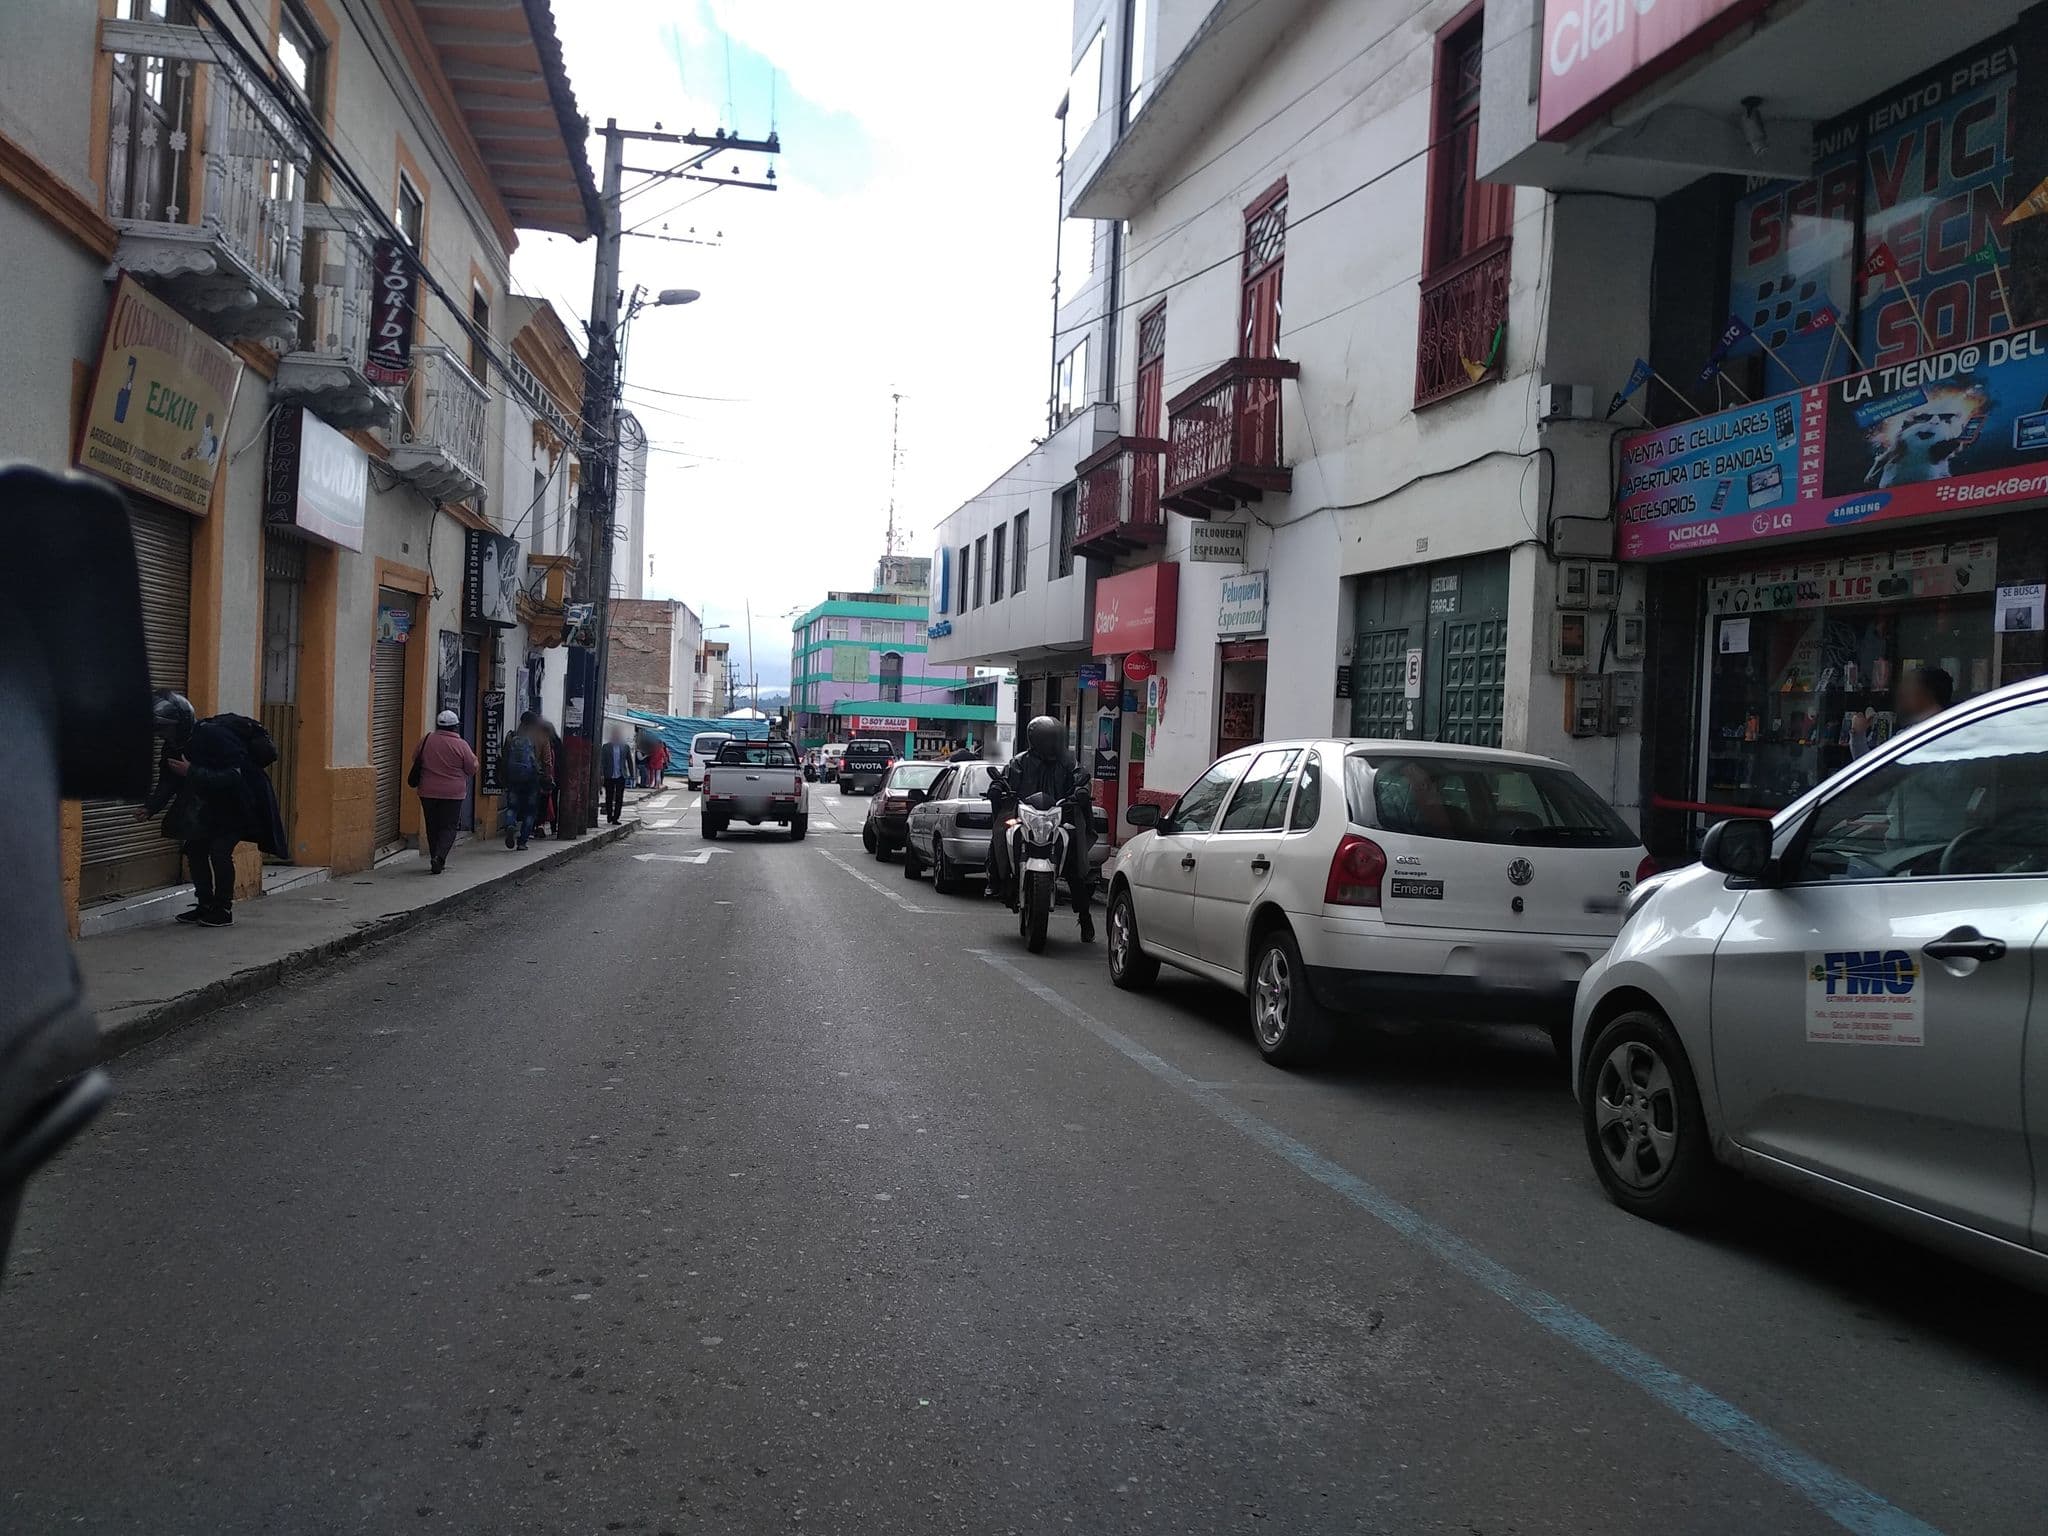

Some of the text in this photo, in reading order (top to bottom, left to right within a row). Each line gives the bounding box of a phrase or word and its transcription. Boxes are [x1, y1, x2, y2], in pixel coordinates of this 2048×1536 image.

[1867, 254, 1885, 273] LTC
[1975, 249, 1990, 262] LTC
[1812, 313, 1829, 329] LTC
[1722, 325, 1740, 347] LTC
[1700, 366, 1714, 381] LTC
[1842, 329, 2045, 403] LA TIEND@ DEL
[1627, 412, 1771, 465] VENTA DE CELULARES
[1801, 387, 1823, 499] INTERNET
[1625, 444, 1774, 497] APERTURA DE BANDAS
[1624, 494, 1697, 524] ACCESORIOS
[1834, 501, 1881, 518] SAMSUNG
[1773, 513, 1792, 529] LG
[1668, 522, 1719, 542] NOKIA
[1193, 544, 1241, 557] ESPERANZA
[1828, 576, 1873, 598] LTC
[2002, 585, 2040, 597] SE BUSCA
[1430, 597, 1456, 614] GARAJE
[1096, 610, 1115, 634] Claro
[1127, 662, 1147, 671] Claro
[884, 719, 907, 727] SALUD
[850, 762, 882, 770] TOYOTA
